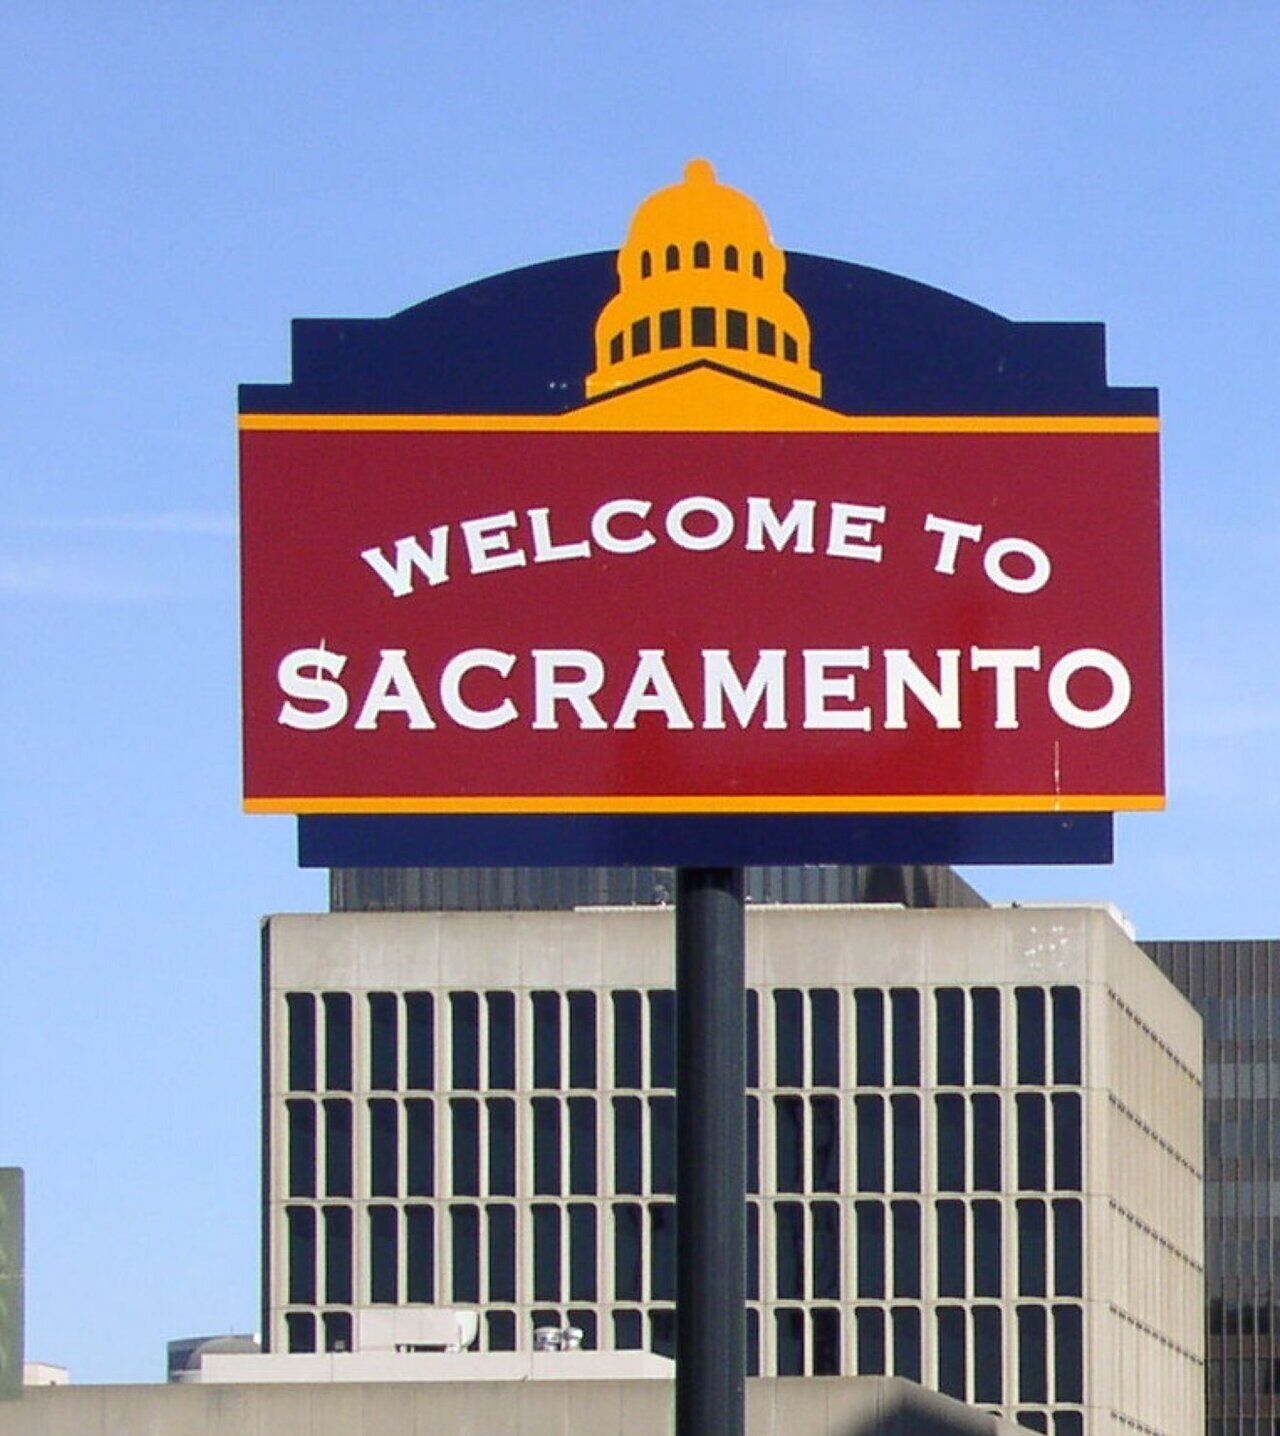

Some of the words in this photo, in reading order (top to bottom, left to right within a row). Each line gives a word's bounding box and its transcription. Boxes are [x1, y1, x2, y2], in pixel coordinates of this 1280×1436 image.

[361, 496, 886, 598] WELCOME
[924, 514, 1051, 594] TO
[277, 646, 1132, 732] SACRAMENTO
